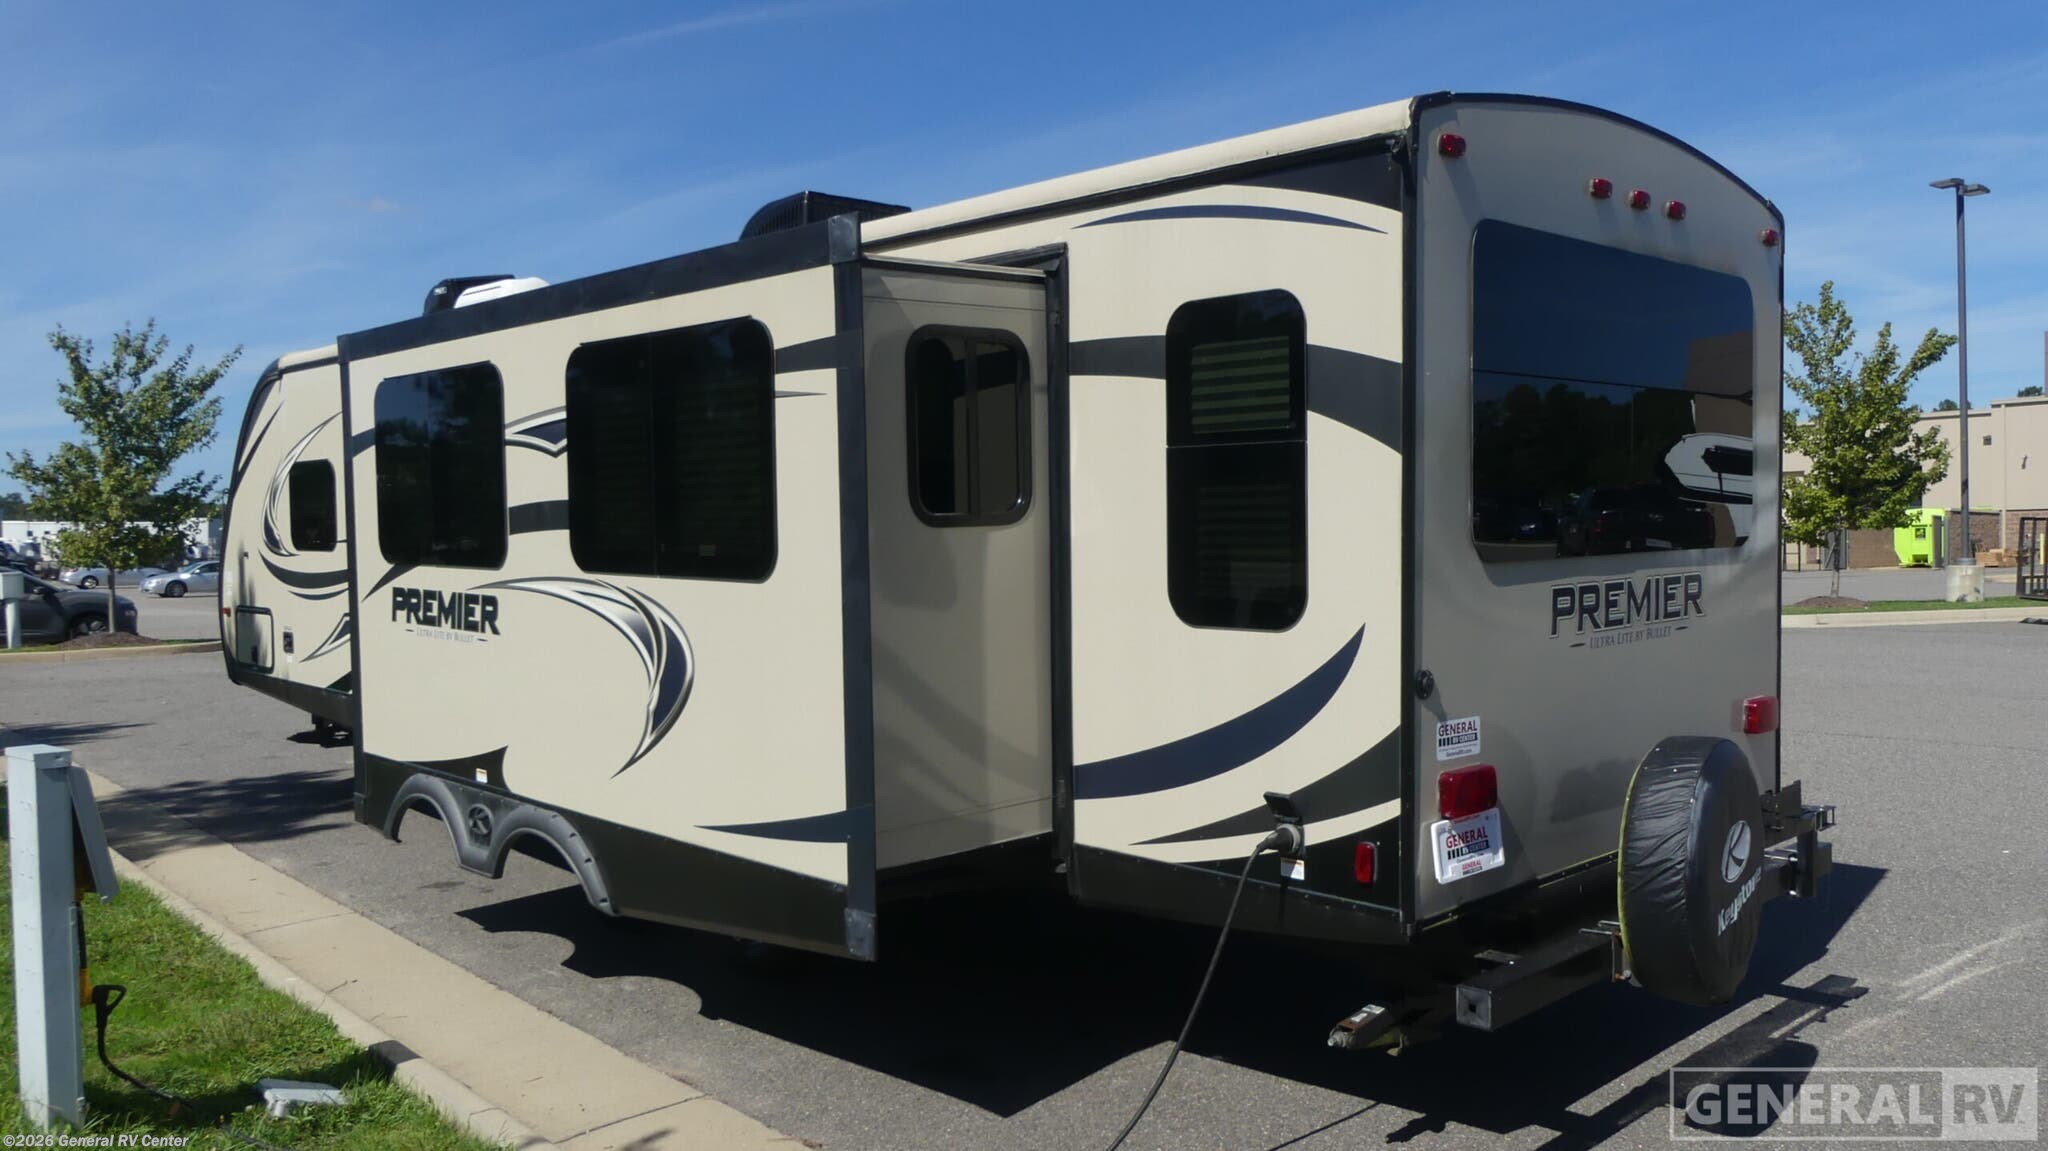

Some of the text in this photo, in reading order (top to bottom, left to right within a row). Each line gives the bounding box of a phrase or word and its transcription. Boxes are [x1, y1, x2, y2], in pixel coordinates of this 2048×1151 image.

[392, 586, 501, 635] PREMIER
[1550, 571, 1704, 639] PREMIER
[1439, 719, 1478, 737] GENERAL
[1446, 826, 1488, 849] GENERAL
